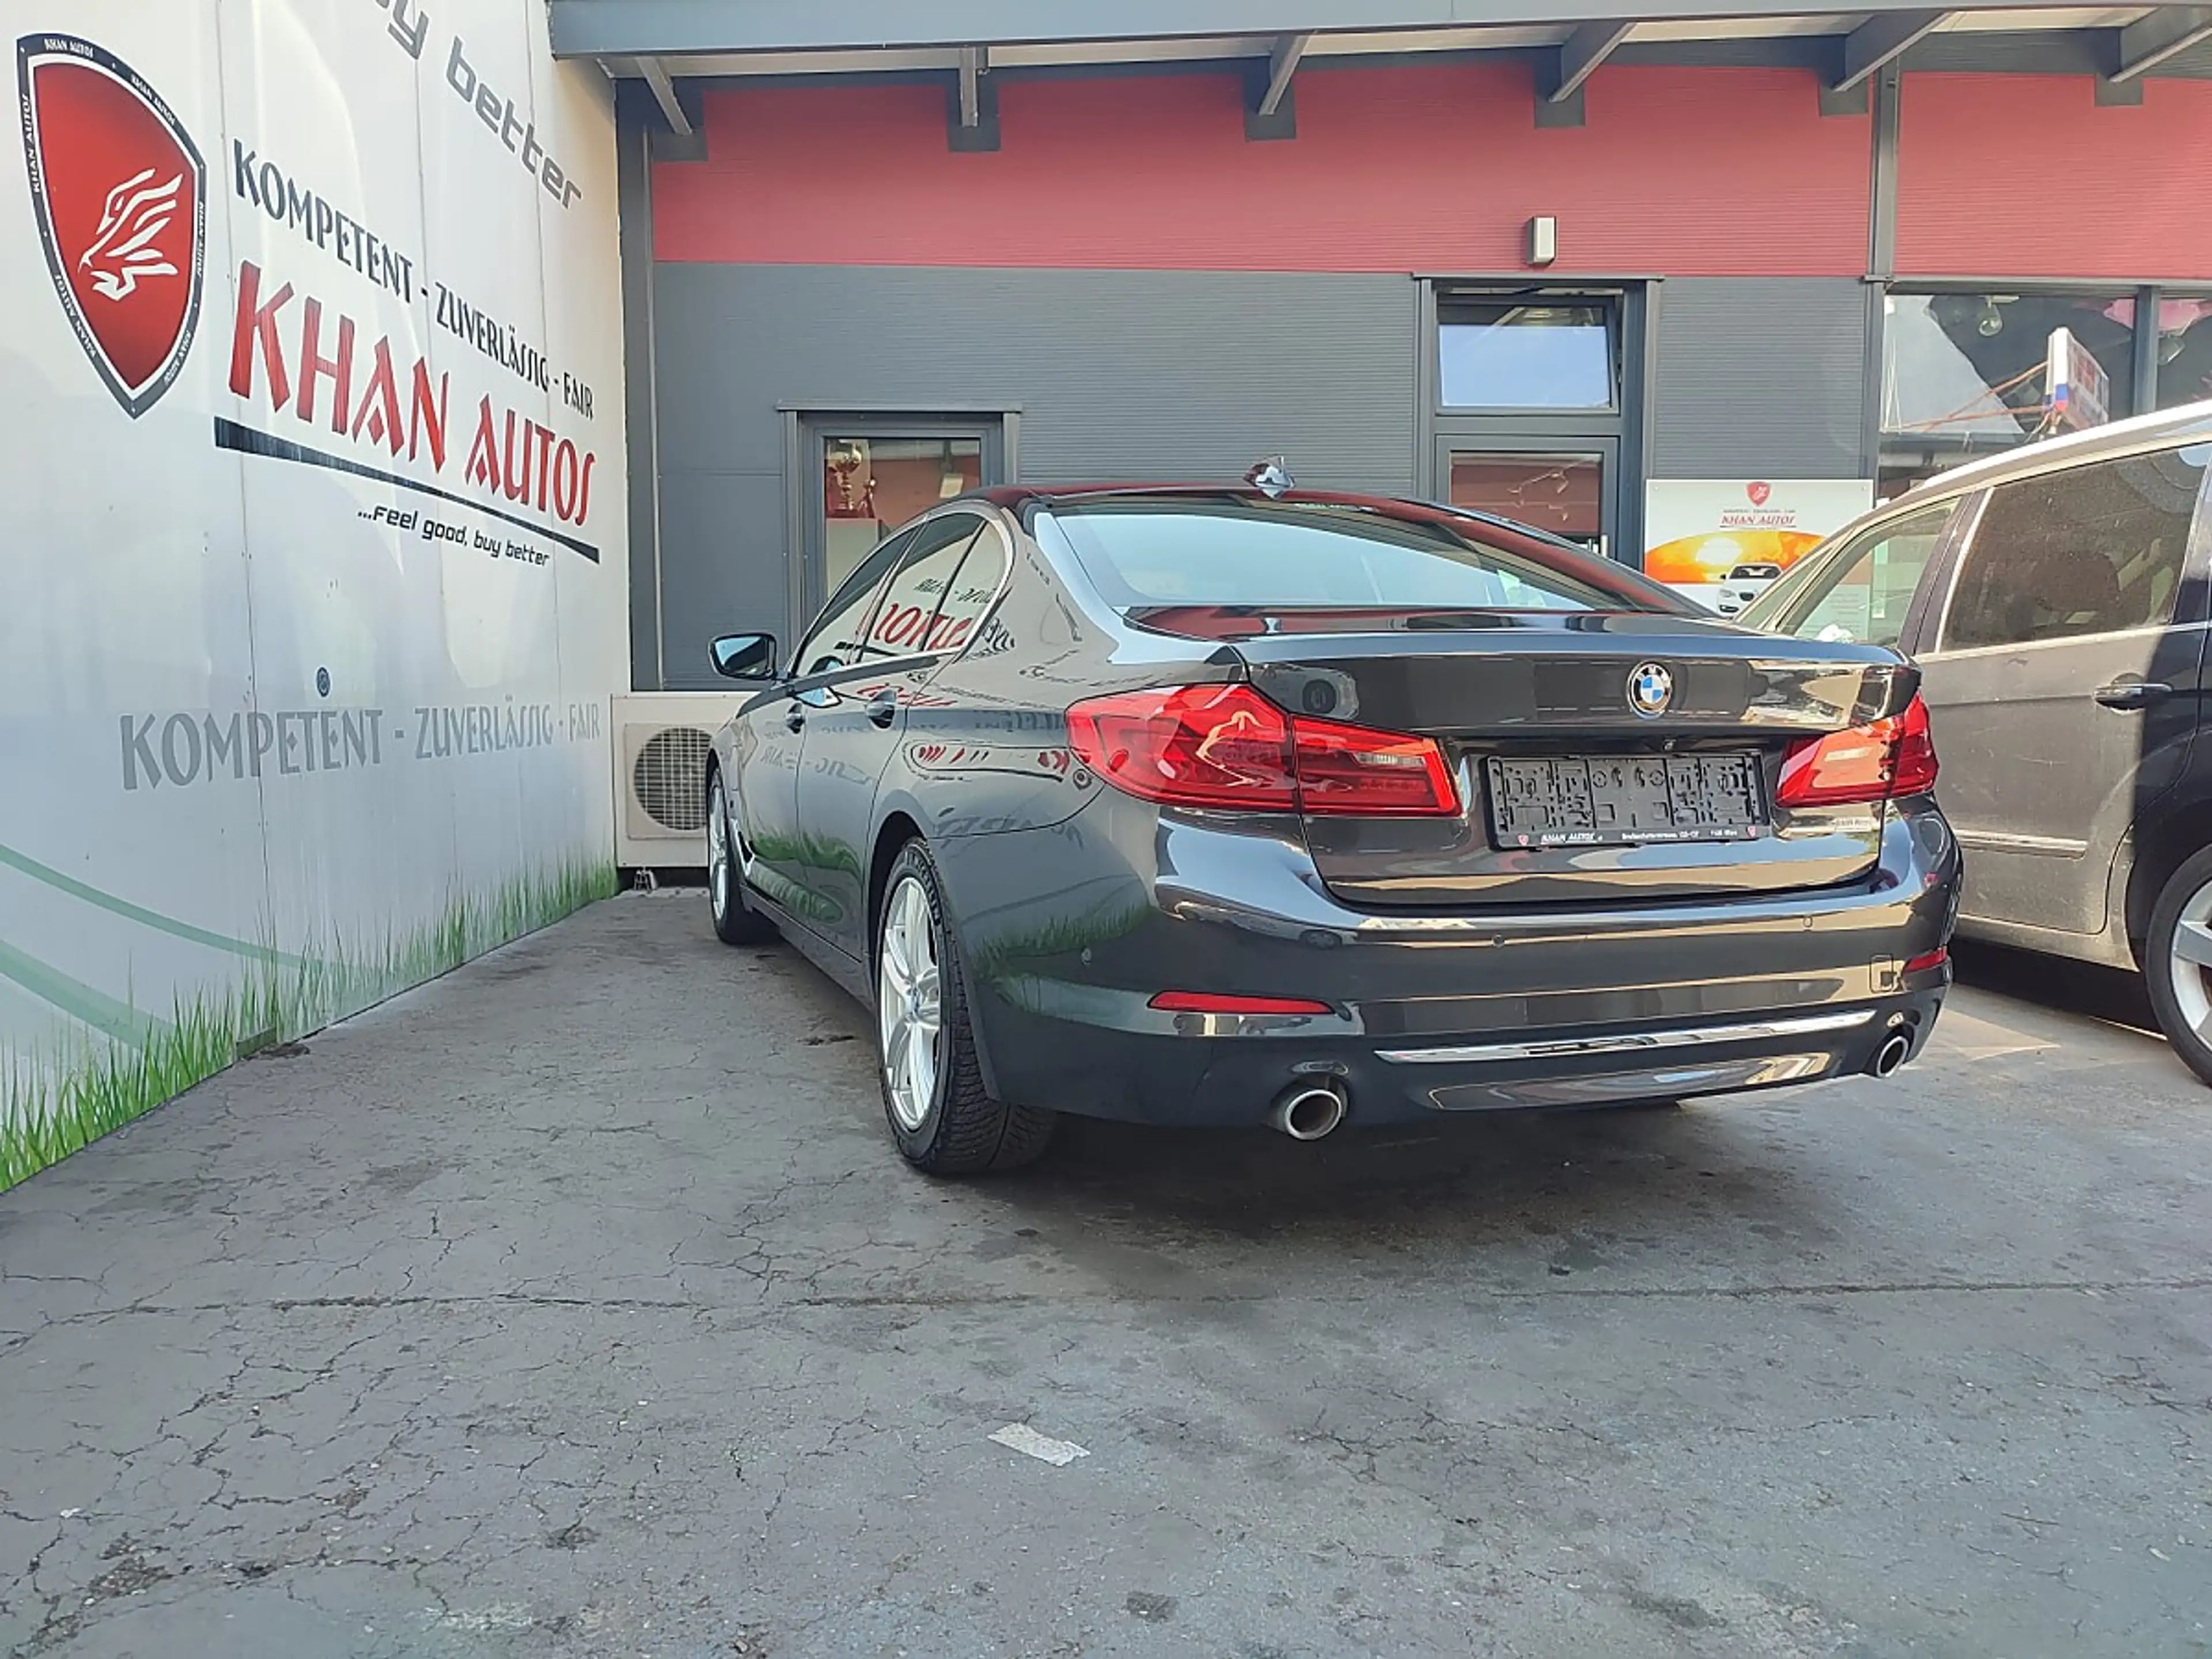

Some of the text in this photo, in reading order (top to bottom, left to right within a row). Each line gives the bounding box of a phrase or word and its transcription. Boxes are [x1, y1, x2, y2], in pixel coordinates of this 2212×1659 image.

[28, 147, 40, 193] KHAN
[377, 0, 581, 209] y better
[234, 138, 412, 303] KOMPETENT
[435, 281, 549, 393] ZUVERLÄSSIG
[564, 372, 593, 421] FAIR
[229, 260, 596, 527] KHAN AUTOS
[422, 519, 468, 547] good,
[474, 529, 501, 558] buy
[505, 540, 550, 566] better
[119, 709, 382, 790] KOMPETENT
[414, 695, 554, 759] ZUVERLÄSSIG
[569, 703, 600, 741] FAIR
